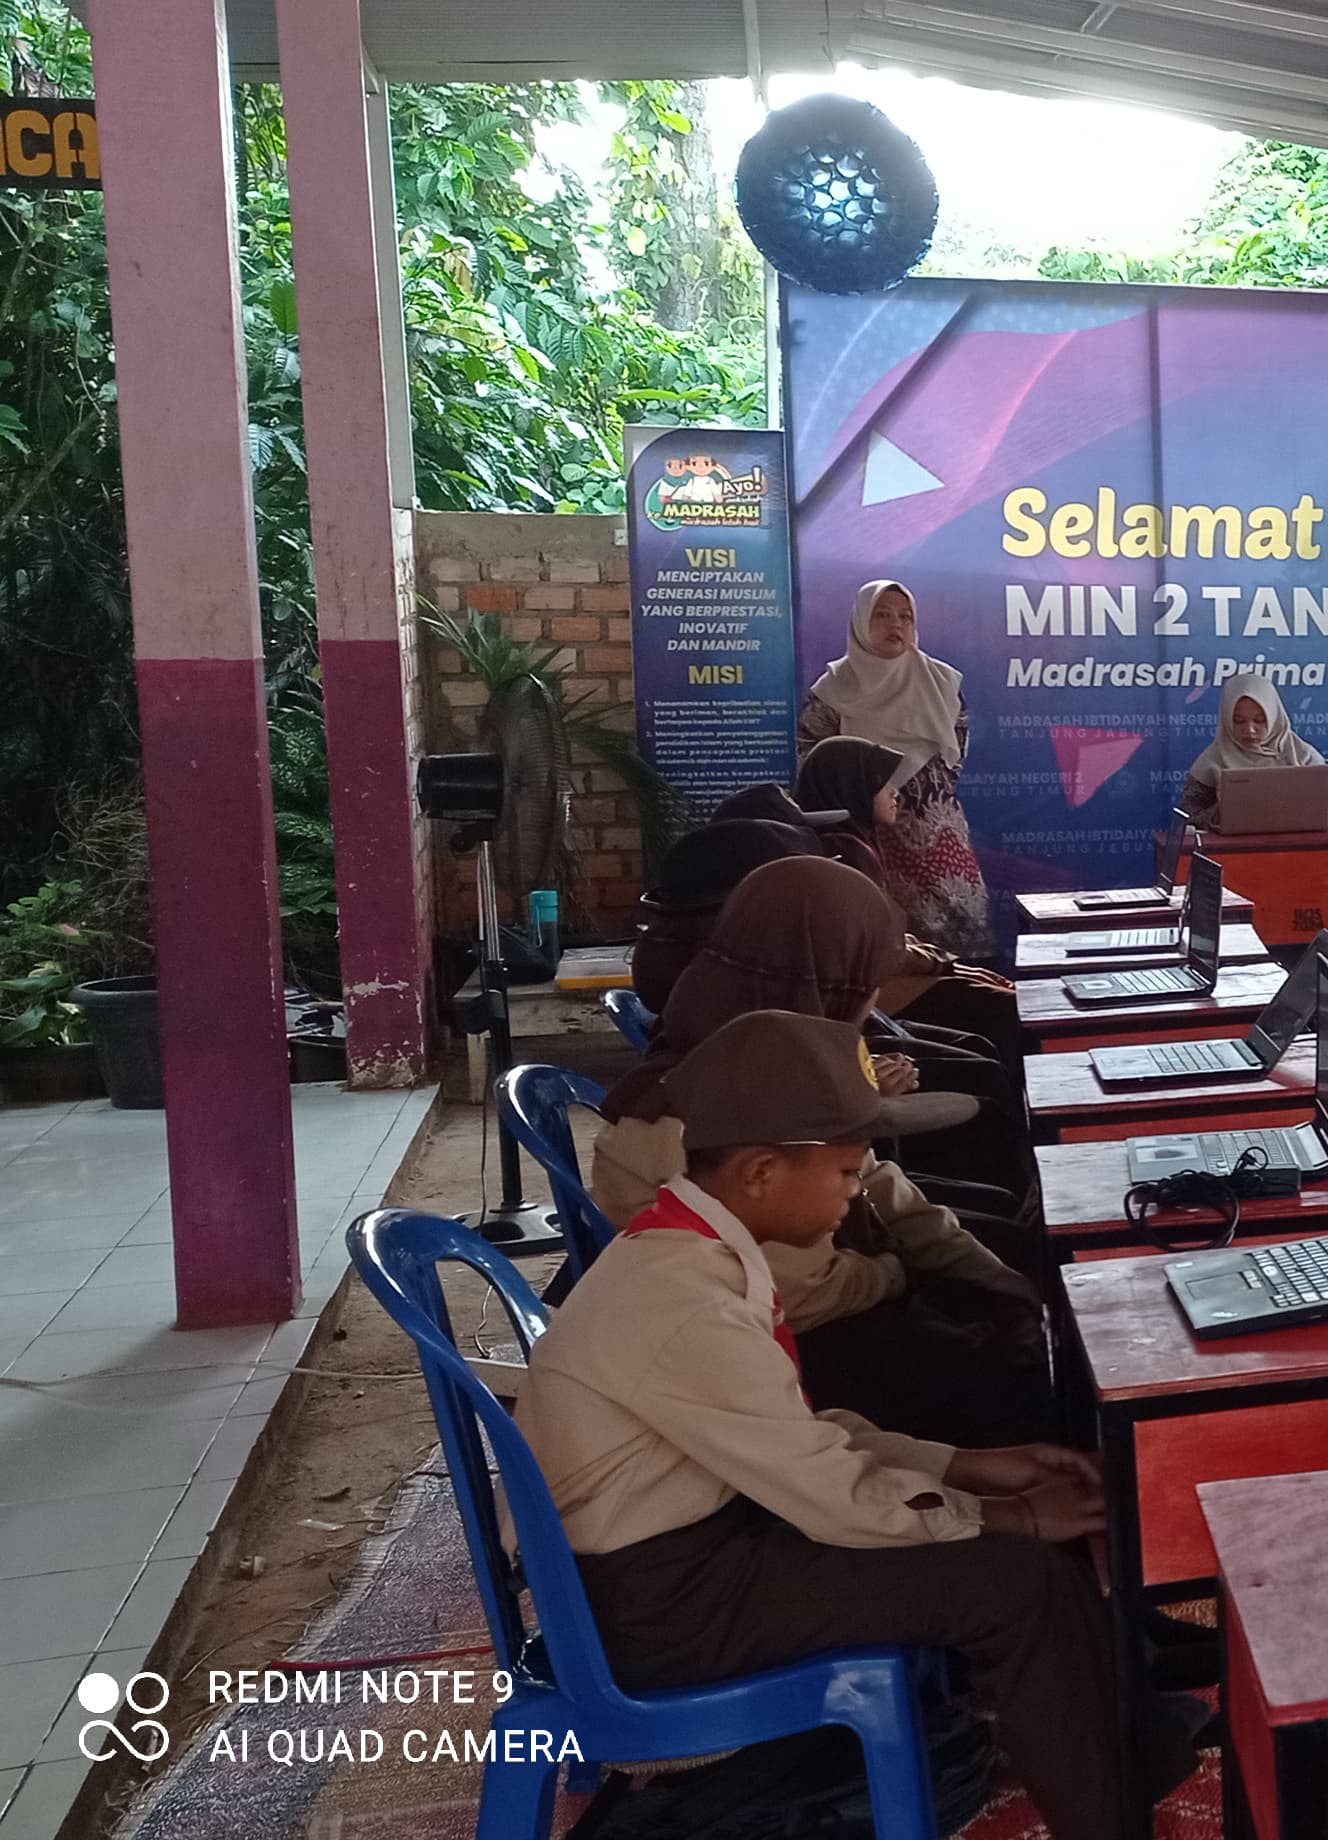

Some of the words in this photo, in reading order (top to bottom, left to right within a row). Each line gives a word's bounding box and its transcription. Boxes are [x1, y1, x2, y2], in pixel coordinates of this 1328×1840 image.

[722, 466, 761, 494] Ayo!
[664, 503, 760, 517] MADRASAH
[1002, 487, 1324, 560] Selamat
[685, 548, 736, 568] VISI
[657, 571, 764, 583] MENCIPTAKAN
[647, 588, 718, 600] GENERASI
[720, 589, 776, 600] MUSLIM
[641, 605, 683, 617] YANG
[686, 605, 782, 618] BERPRESTASI,
[1005, 584, 1137, 636] MIN
[1152, 583, 1190, 636] 2
[679, 622, 748, 634] INOVATIF
[667, 640, 699, 651] DAN
[688, 665, 744, 684] MISI
[1007, 657, 1205, 687] Madrasah
[1213, 653, 1326, 687] Prima
[999, 715, 1083, 727] MADRASAH
[1084, 715, 1165, 726] IBTIDAIYAH
[999, 729, 1087, 738] TANJUNG
[1175, 728, 1218, 737] TIMU
[1002, 831, 1086, 843] MADRASAH
